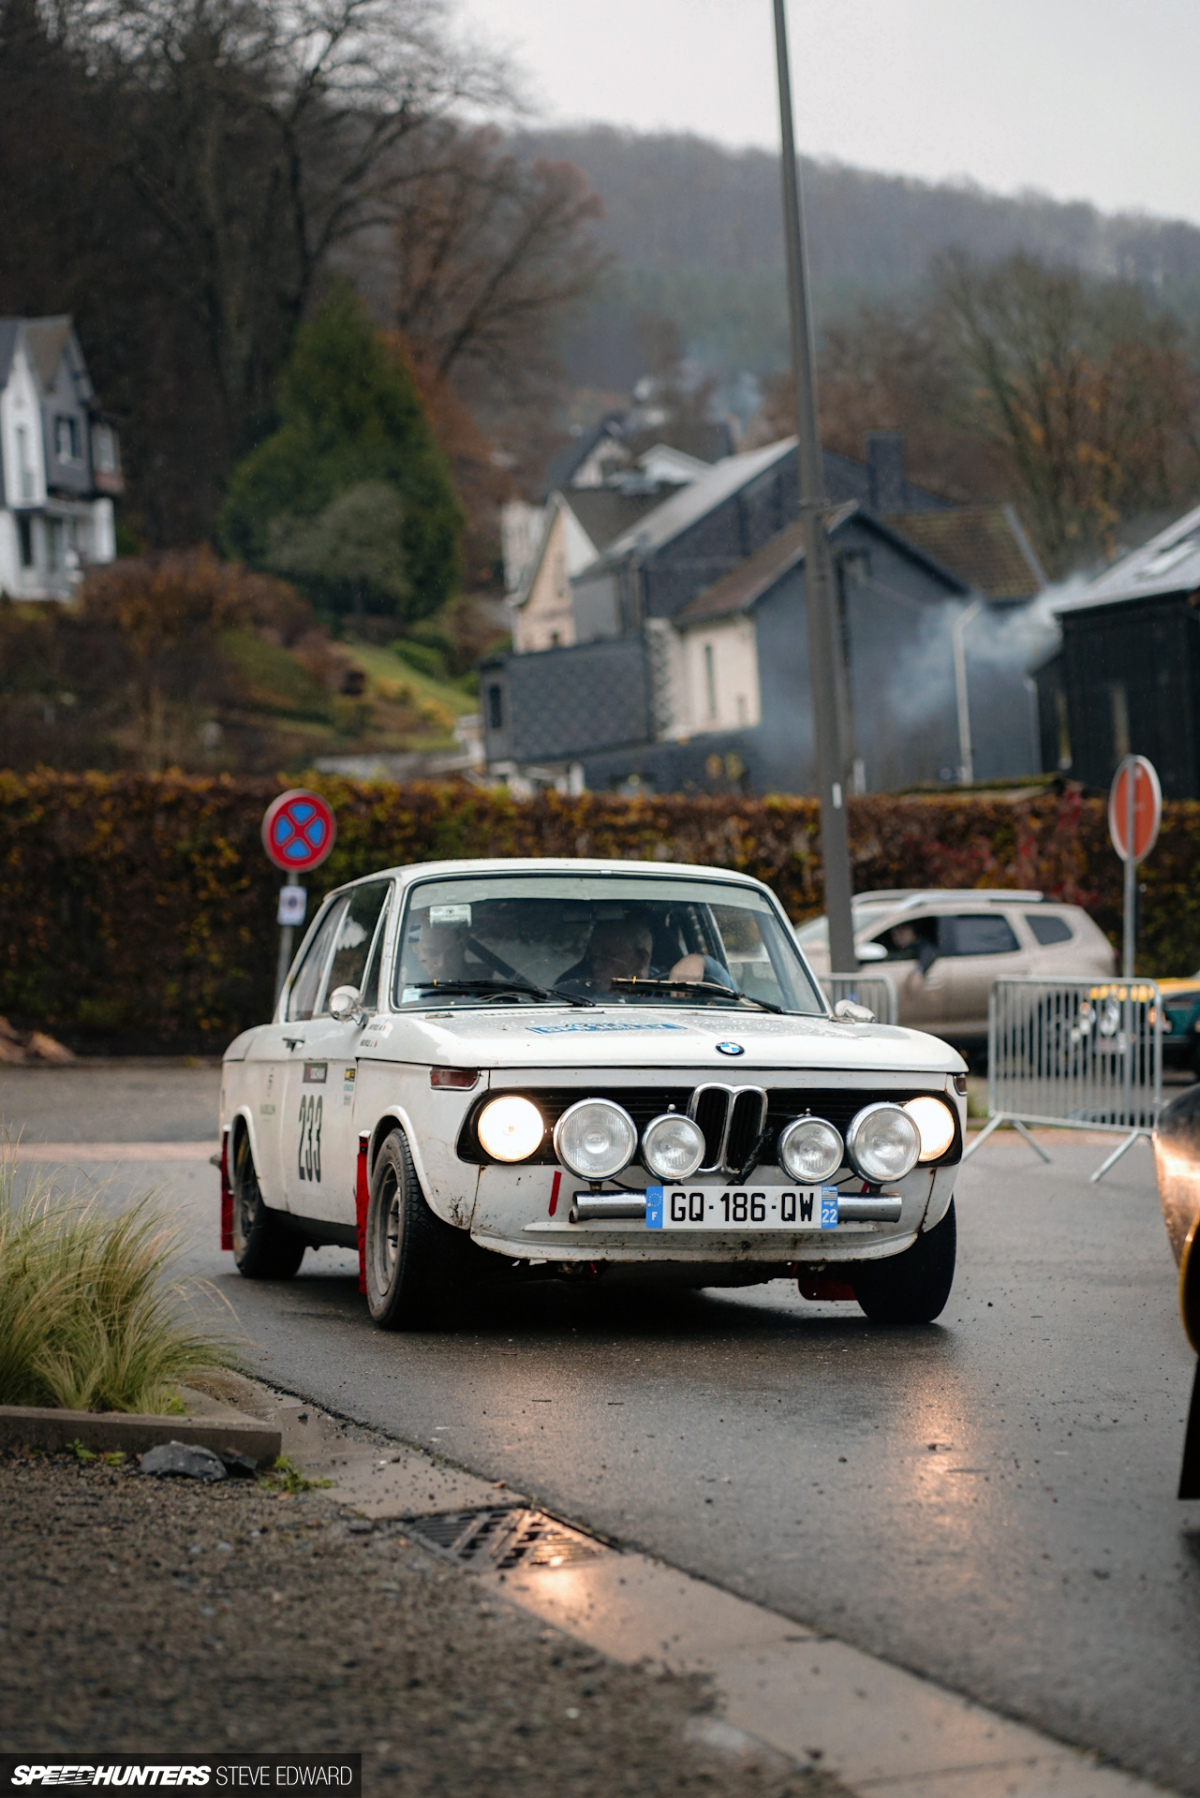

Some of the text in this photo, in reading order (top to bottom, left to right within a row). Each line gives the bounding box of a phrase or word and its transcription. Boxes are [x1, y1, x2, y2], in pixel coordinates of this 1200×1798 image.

[299, 1094, 323, 1183] 233
[651, 1211, 658, 1221] F
[822, 1208, 838, 1224] 22
